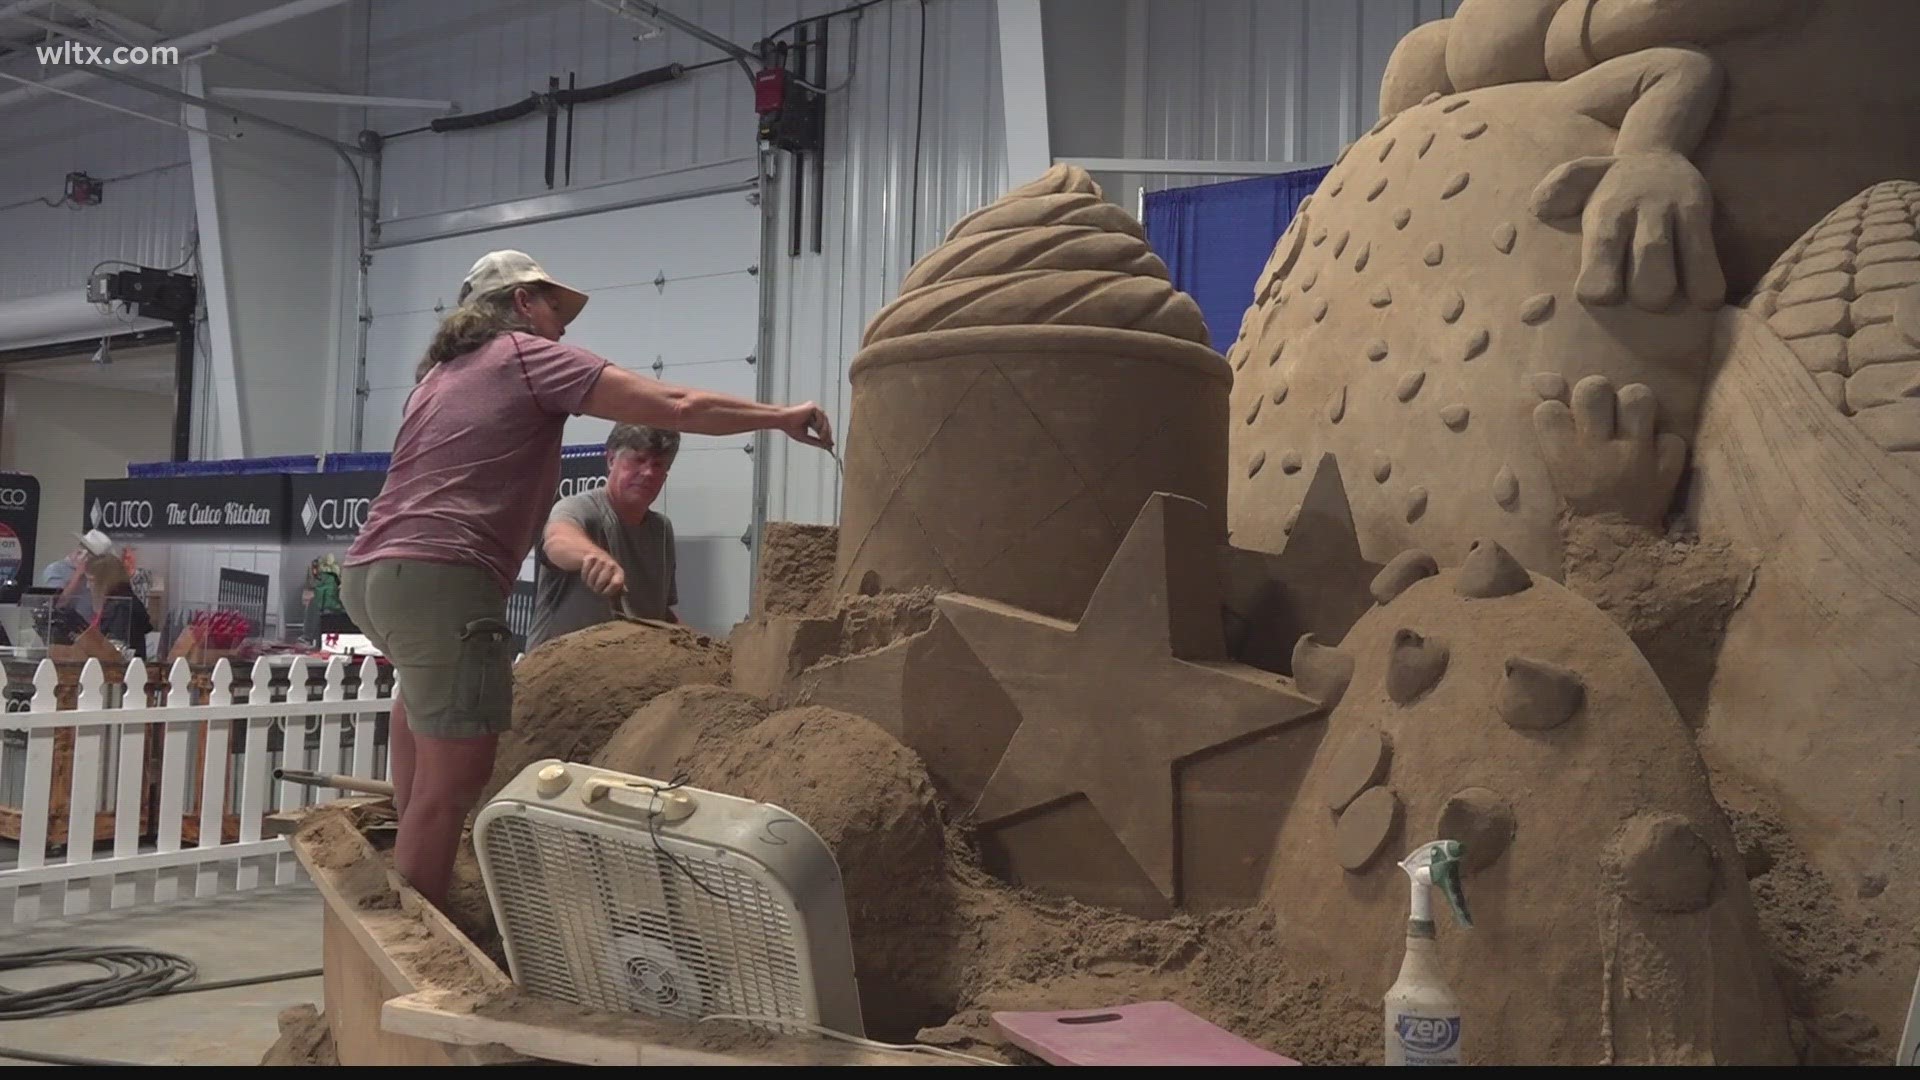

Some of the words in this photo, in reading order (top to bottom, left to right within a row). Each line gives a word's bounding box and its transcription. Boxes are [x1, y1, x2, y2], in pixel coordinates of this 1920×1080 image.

[103, 500, 153, 528] CUTCO
[166, 502, 188, 525] The
[189, 502, 223, 525] Cutco
[224, 501, 271, 525] Kitchen
[318, 498, 370, 529] CUTC
